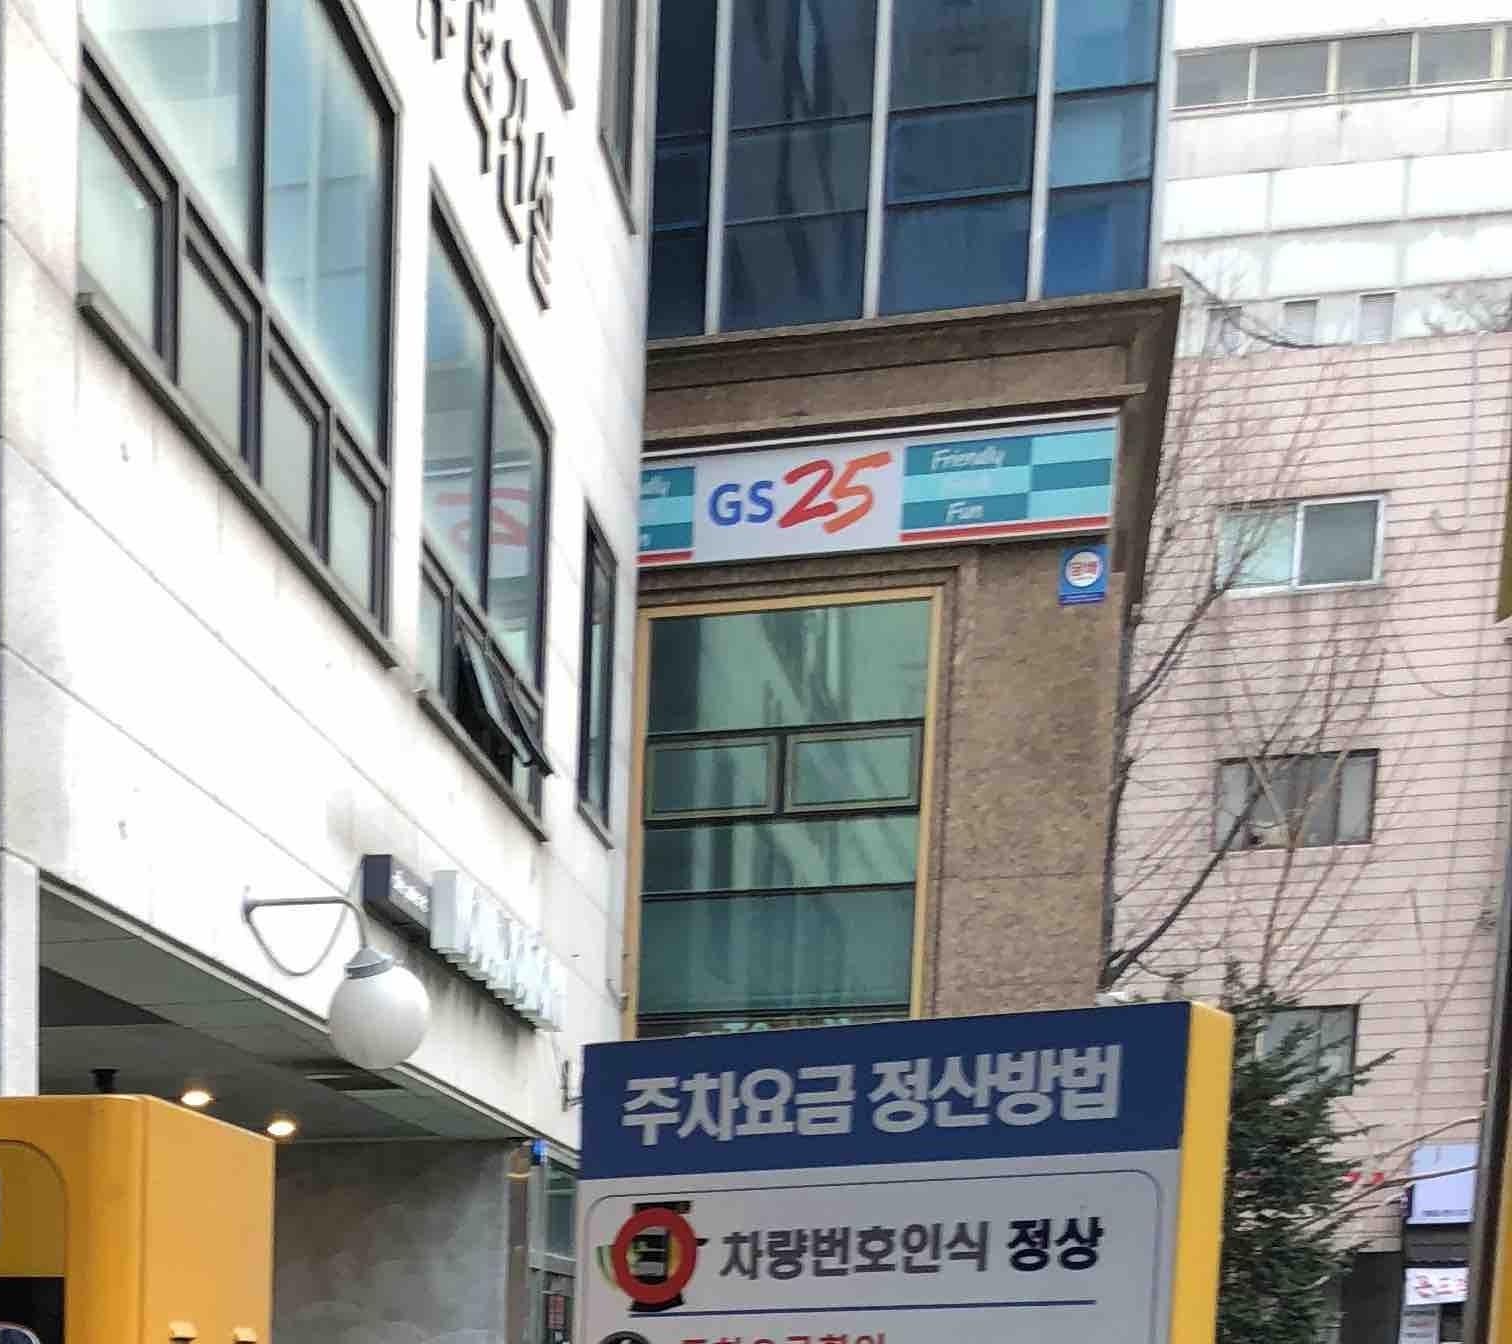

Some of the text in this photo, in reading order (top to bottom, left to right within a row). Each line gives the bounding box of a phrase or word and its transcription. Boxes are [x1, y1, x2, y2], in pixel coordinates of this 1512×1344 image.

[707, 451, 894, 534] GS25
[621, 1044, 1123, 1146] 주차요금 정산방법
[719, 1216, 1104, 1281] 차량번호인식 정상
